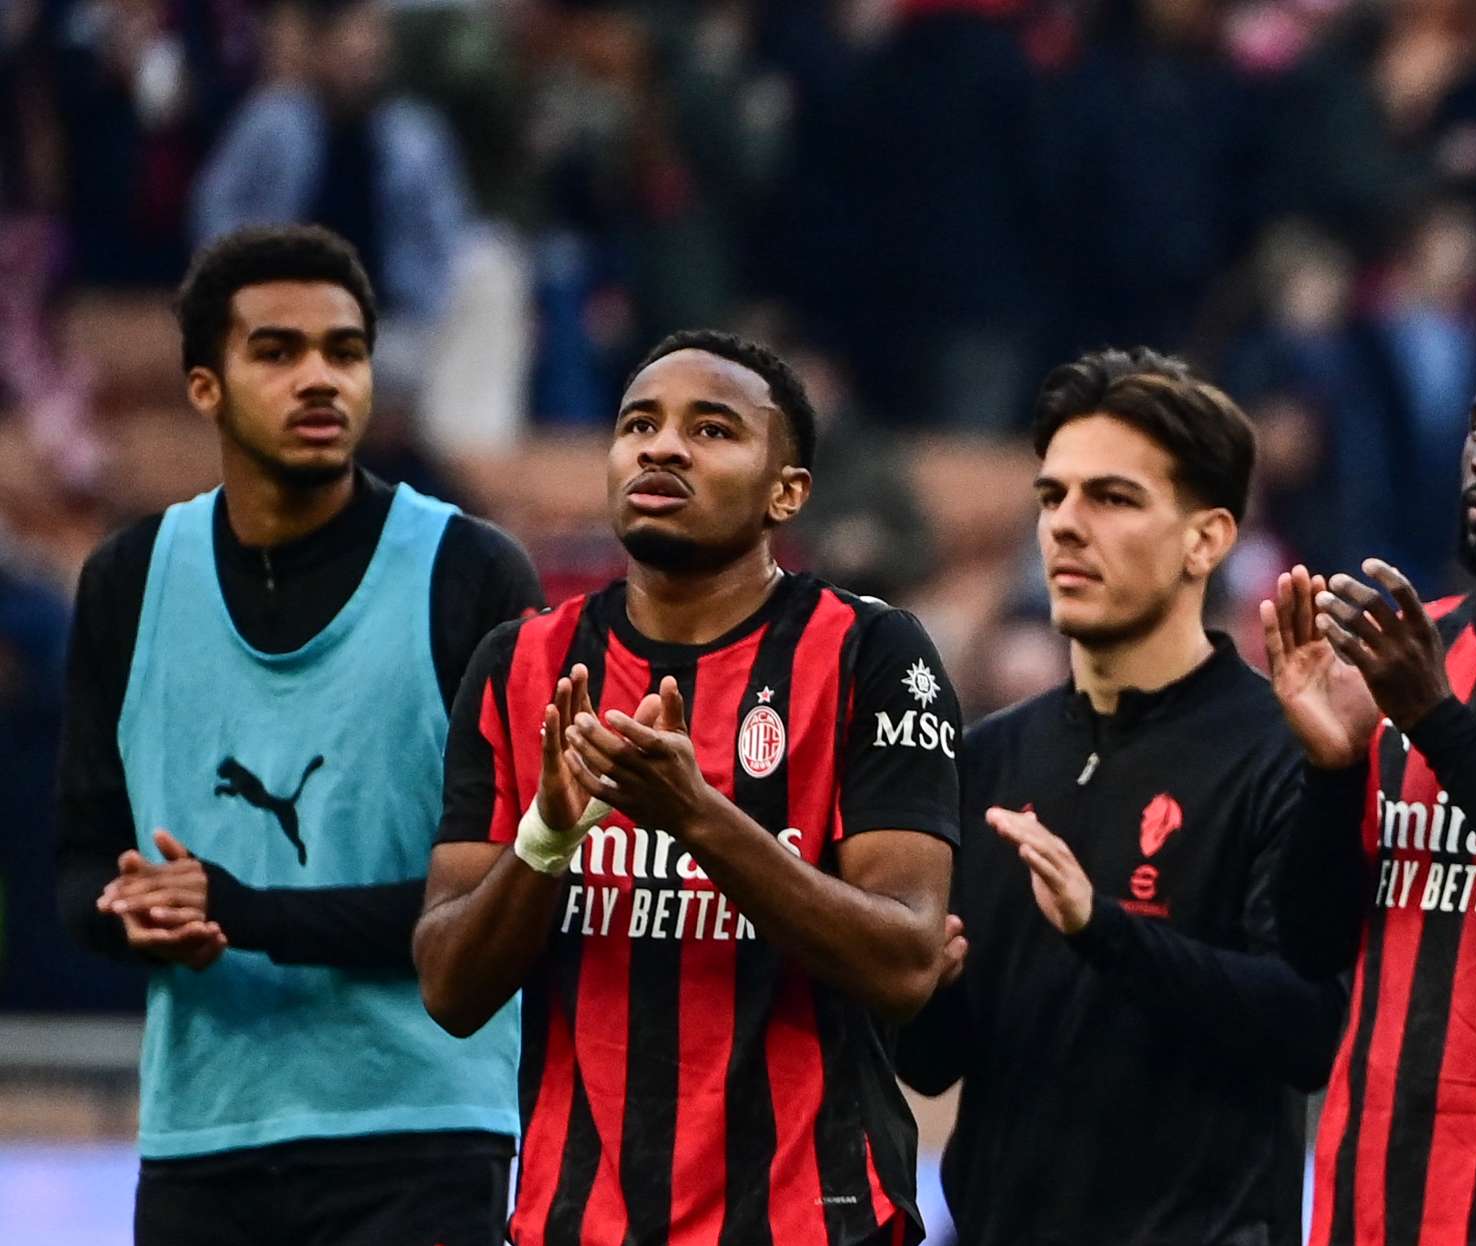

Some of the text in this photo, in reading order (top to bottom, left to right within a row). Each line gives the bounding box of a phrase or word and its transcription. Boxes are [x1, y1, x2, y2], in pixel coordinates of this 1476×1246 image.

[874, 709, 956, 760] MSC
[560, 884, 619, 935] FLY
[1375, 859, 1420, 909] FLY
